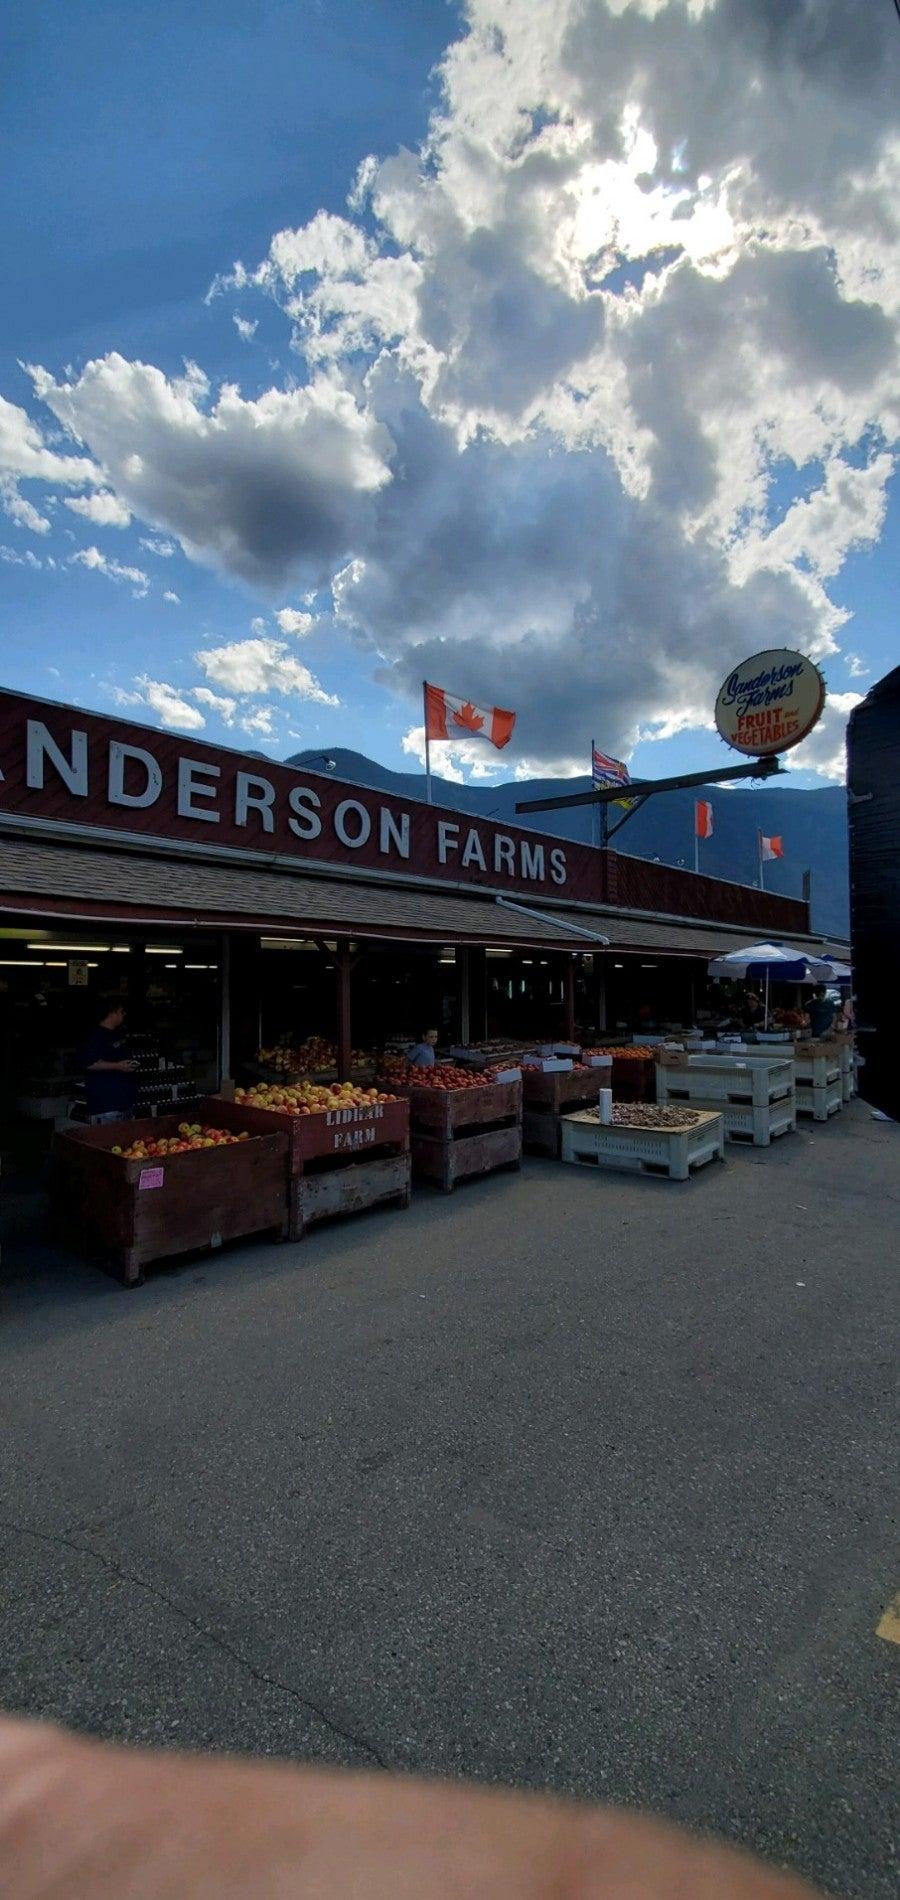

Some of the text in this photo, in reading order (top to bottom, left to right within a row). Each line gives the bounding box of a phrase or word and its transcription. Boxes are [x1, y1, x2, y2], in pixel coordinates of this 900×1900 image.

[722, 662, 804, 705] Sanderson
[736, 680, 793, 717] Farms
[731, 720, 798, 746] VEGETABLES
[738, 708, 783, 731] FRUIT
[0, 719, 568, 886] NDERSON FARMS
[334, 1127, 376, 1149] FARM
